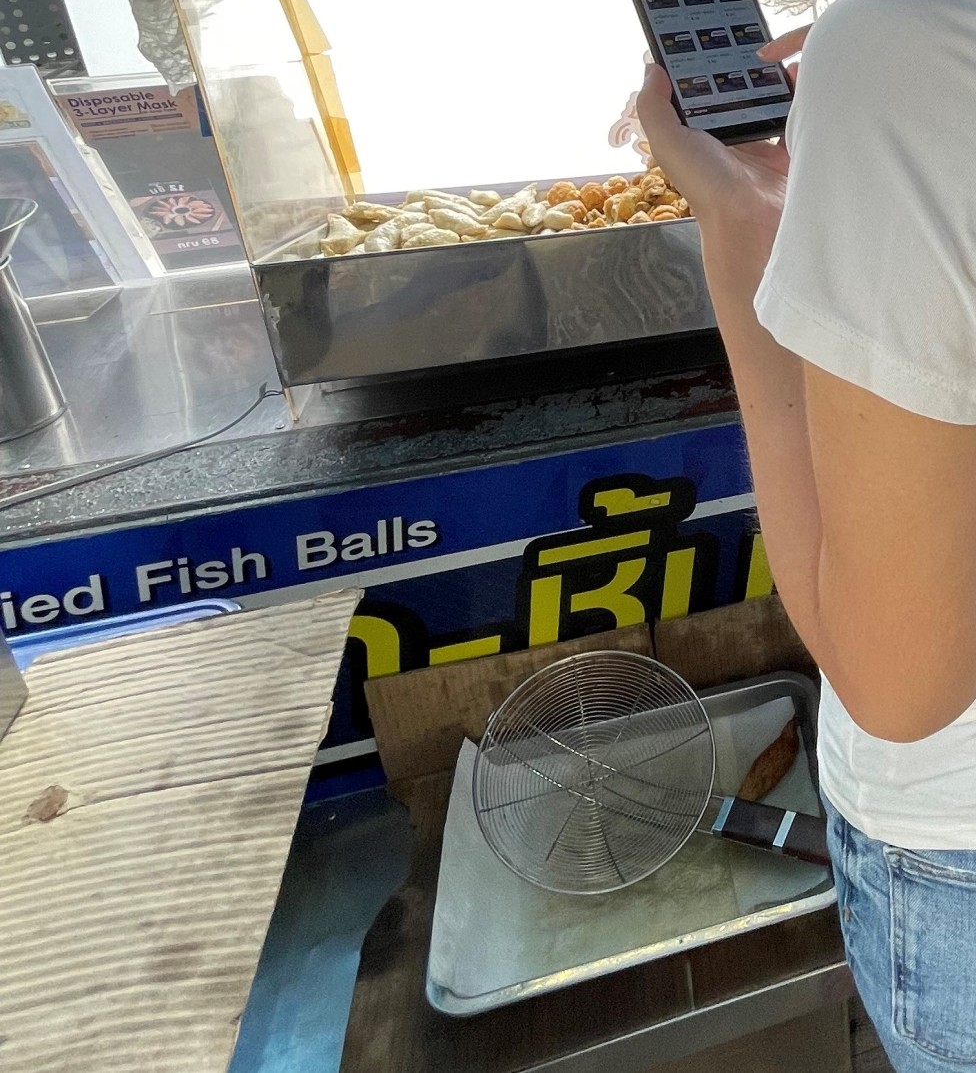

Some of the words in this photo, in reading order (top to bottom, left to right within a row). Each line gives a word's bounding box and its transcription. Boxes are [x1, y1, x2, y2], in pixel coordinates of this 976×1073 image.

[67, 91, 155, 108] Disposable
[72, 103, 133, 117] 3-Layer
[136, 99, 178, 112] Mask
[1, 573, 105, 629] ied
[136, 547, 267, 602] Fish
[296, 516, 438, 571] Balls
